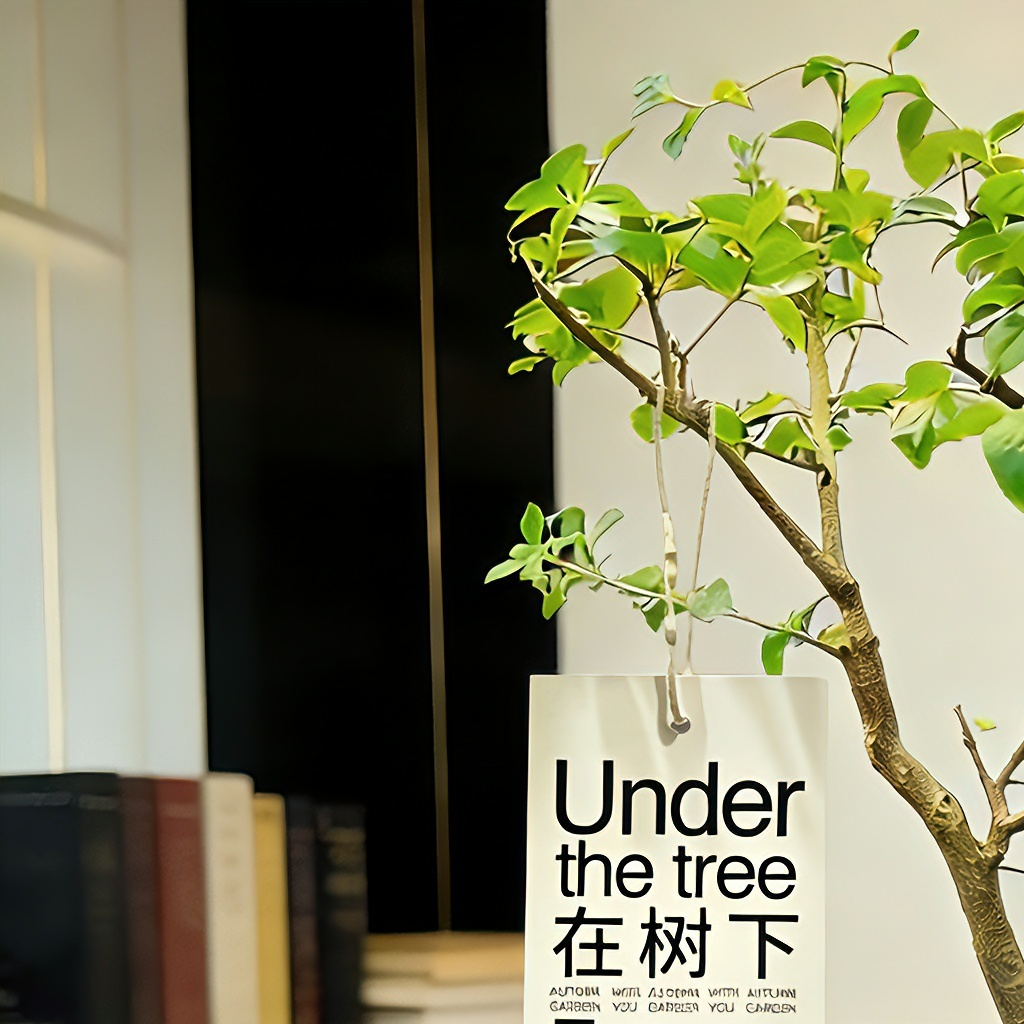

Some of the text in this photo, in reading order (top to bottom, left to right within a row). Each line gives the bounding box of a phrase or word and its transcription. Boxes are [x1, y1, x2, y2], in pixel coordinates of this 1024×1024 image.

[556, 759, 805, 837] Under
[555, 840, 797, 899] the tree
[552, 906, 799, 980] 在树下
